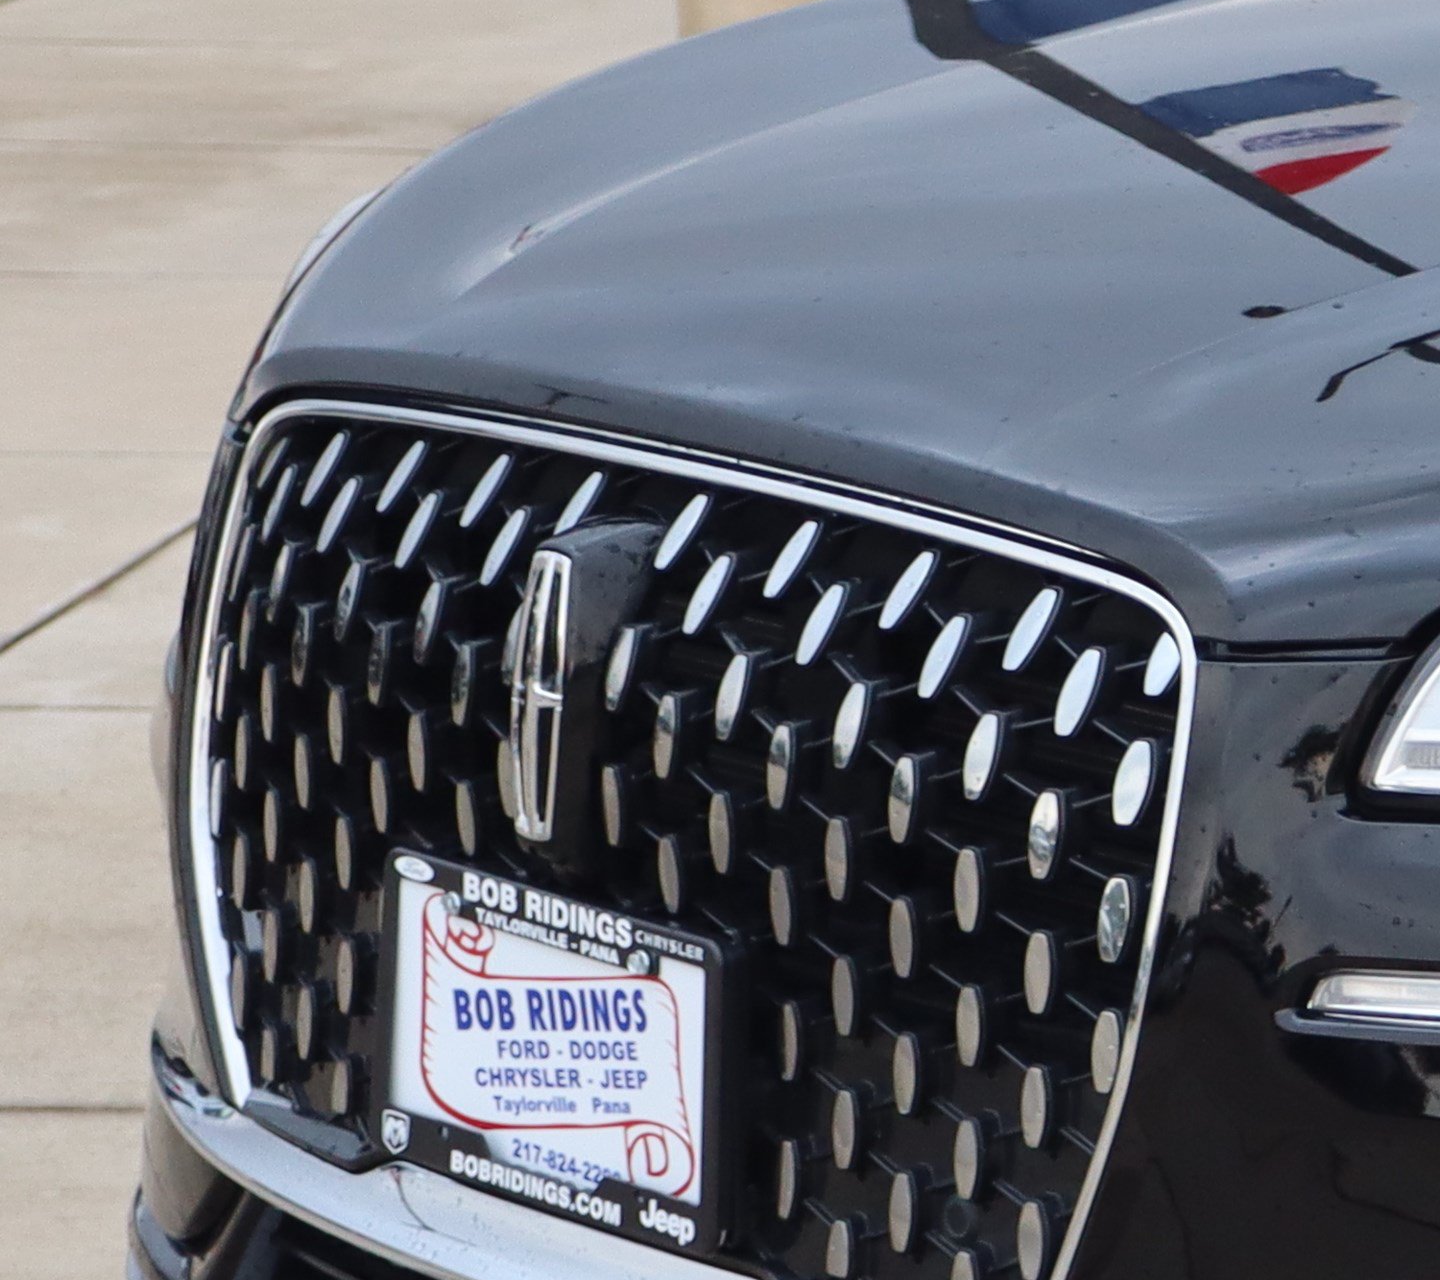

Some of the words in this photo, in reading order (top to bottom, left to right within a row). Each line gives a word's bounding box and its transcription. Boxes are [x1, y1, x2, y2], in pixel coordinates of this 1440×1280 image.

[462, 871, 518, 913] BOB
[524, 889, 633, 948] RIDINGS
[475, 907, 569, 950] TAYLORVILLE
[579, 940, 621, 966] PANA
[634, 929, 705, 962] CHRYSLER
[453, 988, 516, 1031] BOB
[526, 988, 648, 1033] RIDINGS
[497, 1039, 551, 1060] FORD
[568, 1040, 639, 1061] DODGE
[474, 1068, 582, 1089] CHRYSLER
[600, 1069, 648, 1090] JEEP
[493, 1095, 577, 1116] Taylorville
[591, 1096, 632, 1115] Pana
[449, 1149, 623, 1227] BOBRIDINGS.COM
[639, 1198, 696, 1247] Jeep
